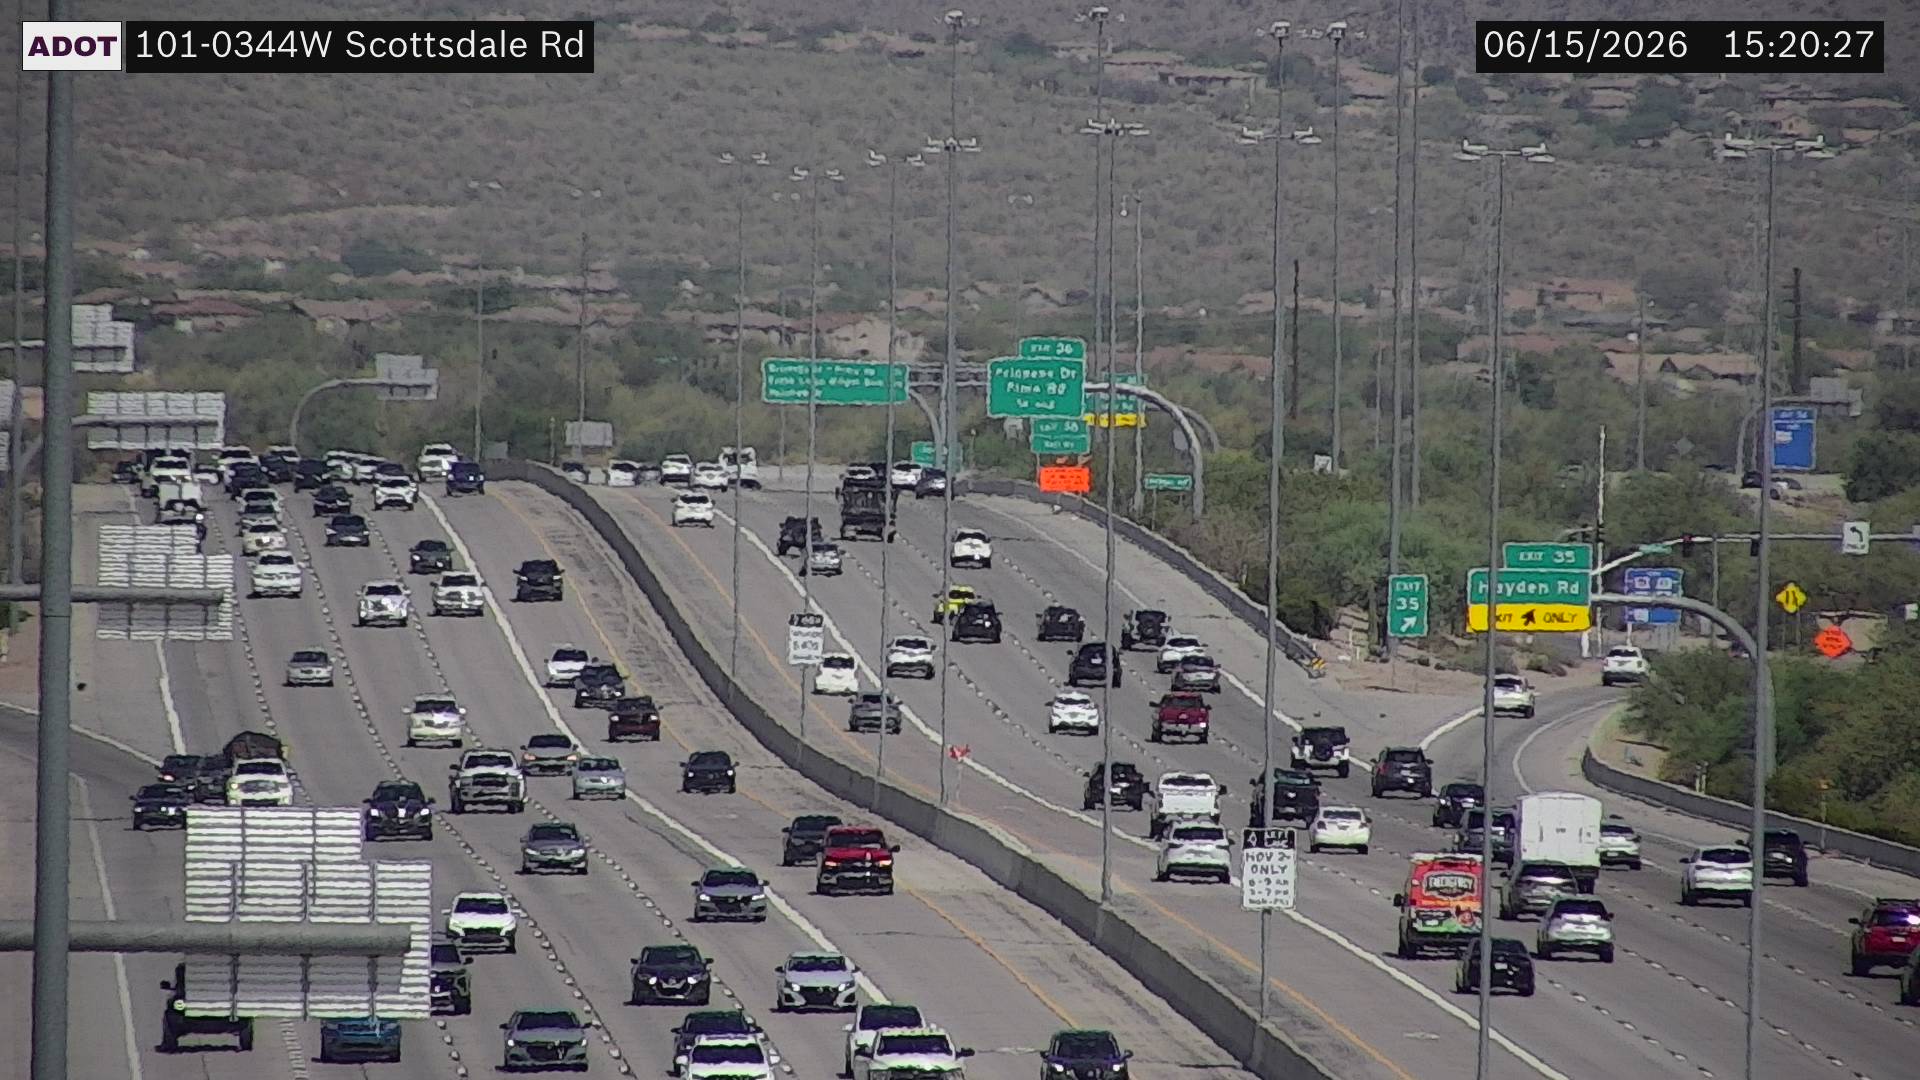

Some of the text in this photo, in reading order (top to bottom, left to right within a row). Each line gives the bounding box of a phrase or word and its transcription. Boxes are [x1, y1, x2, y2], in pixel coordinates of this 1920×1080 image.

[1060, 366, 1077, 379] Dr
[1519, 550, 1576, 563] EXIT 35
[1557, 580, 1580, 595] Rd
[1396, 581, 1422, 611] EXIT 35
[1543, 612, 1578, 623] ONLY
[1245, 852, 1274, 863] HOV
[1251, 864, 1288, 875] ONLY
